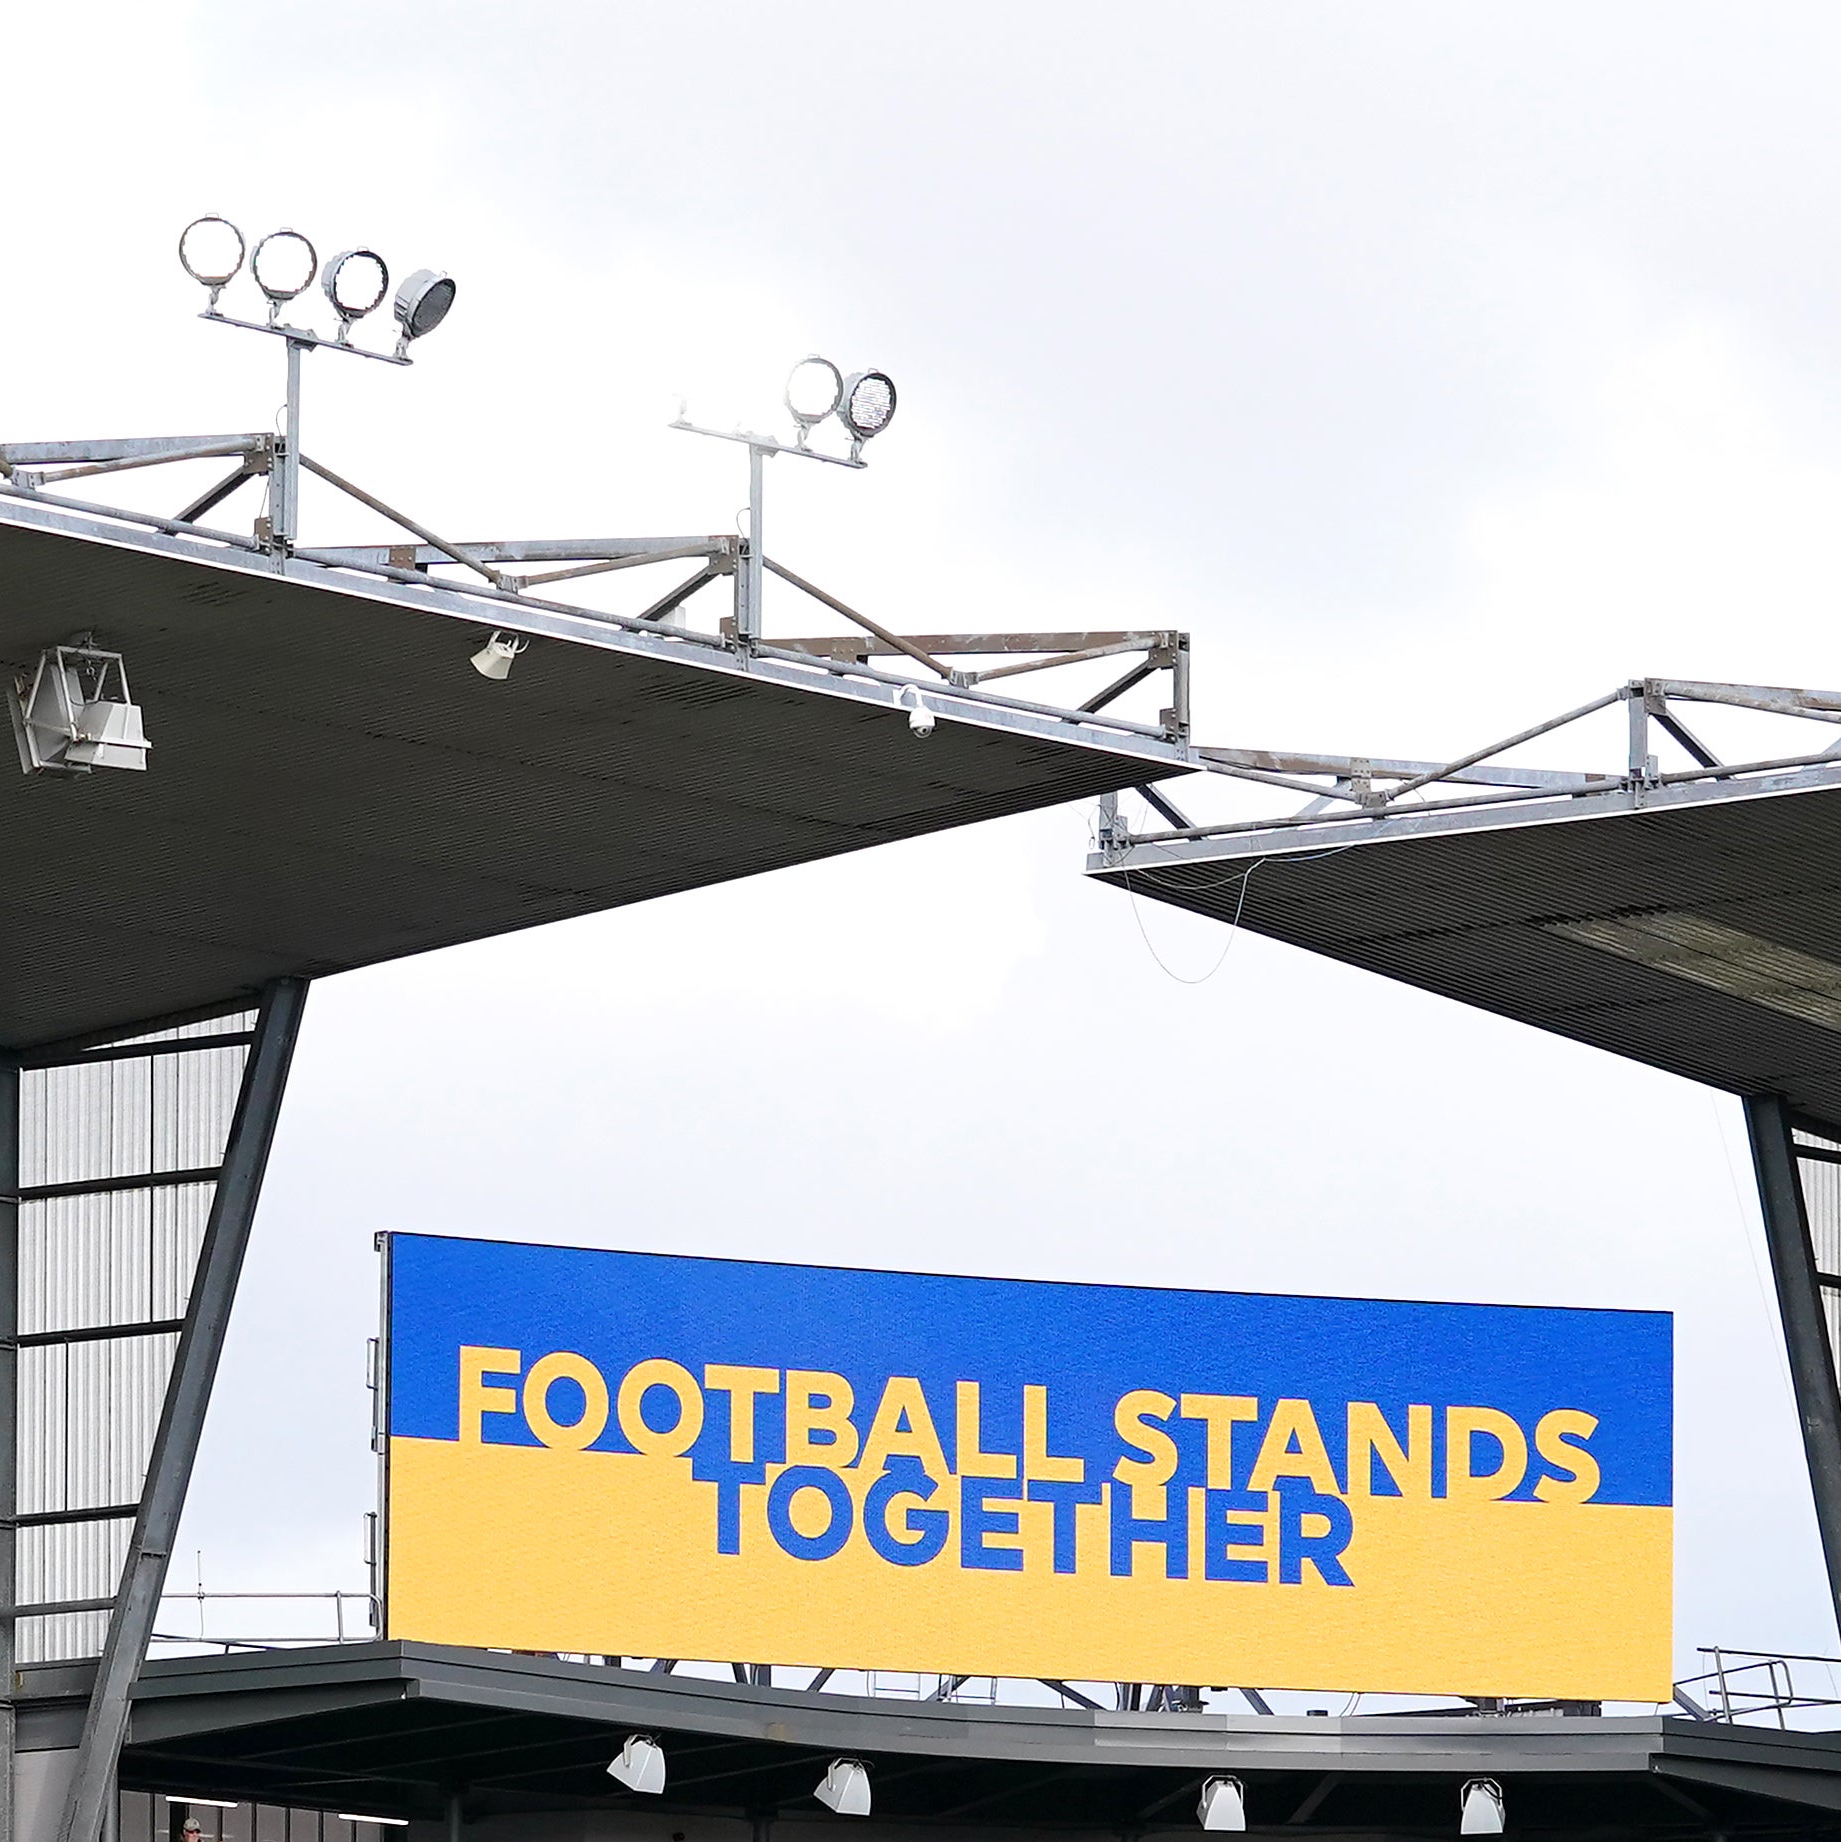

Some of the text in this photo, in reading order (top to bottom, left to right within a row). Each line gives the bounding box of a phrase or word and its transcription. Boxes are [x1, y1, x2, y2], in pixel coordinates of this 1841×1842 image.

[459, 1345, 1600, 1503] FOOTBALL STANDS
[692, 1457, 1355, 1587] TOGETHER
